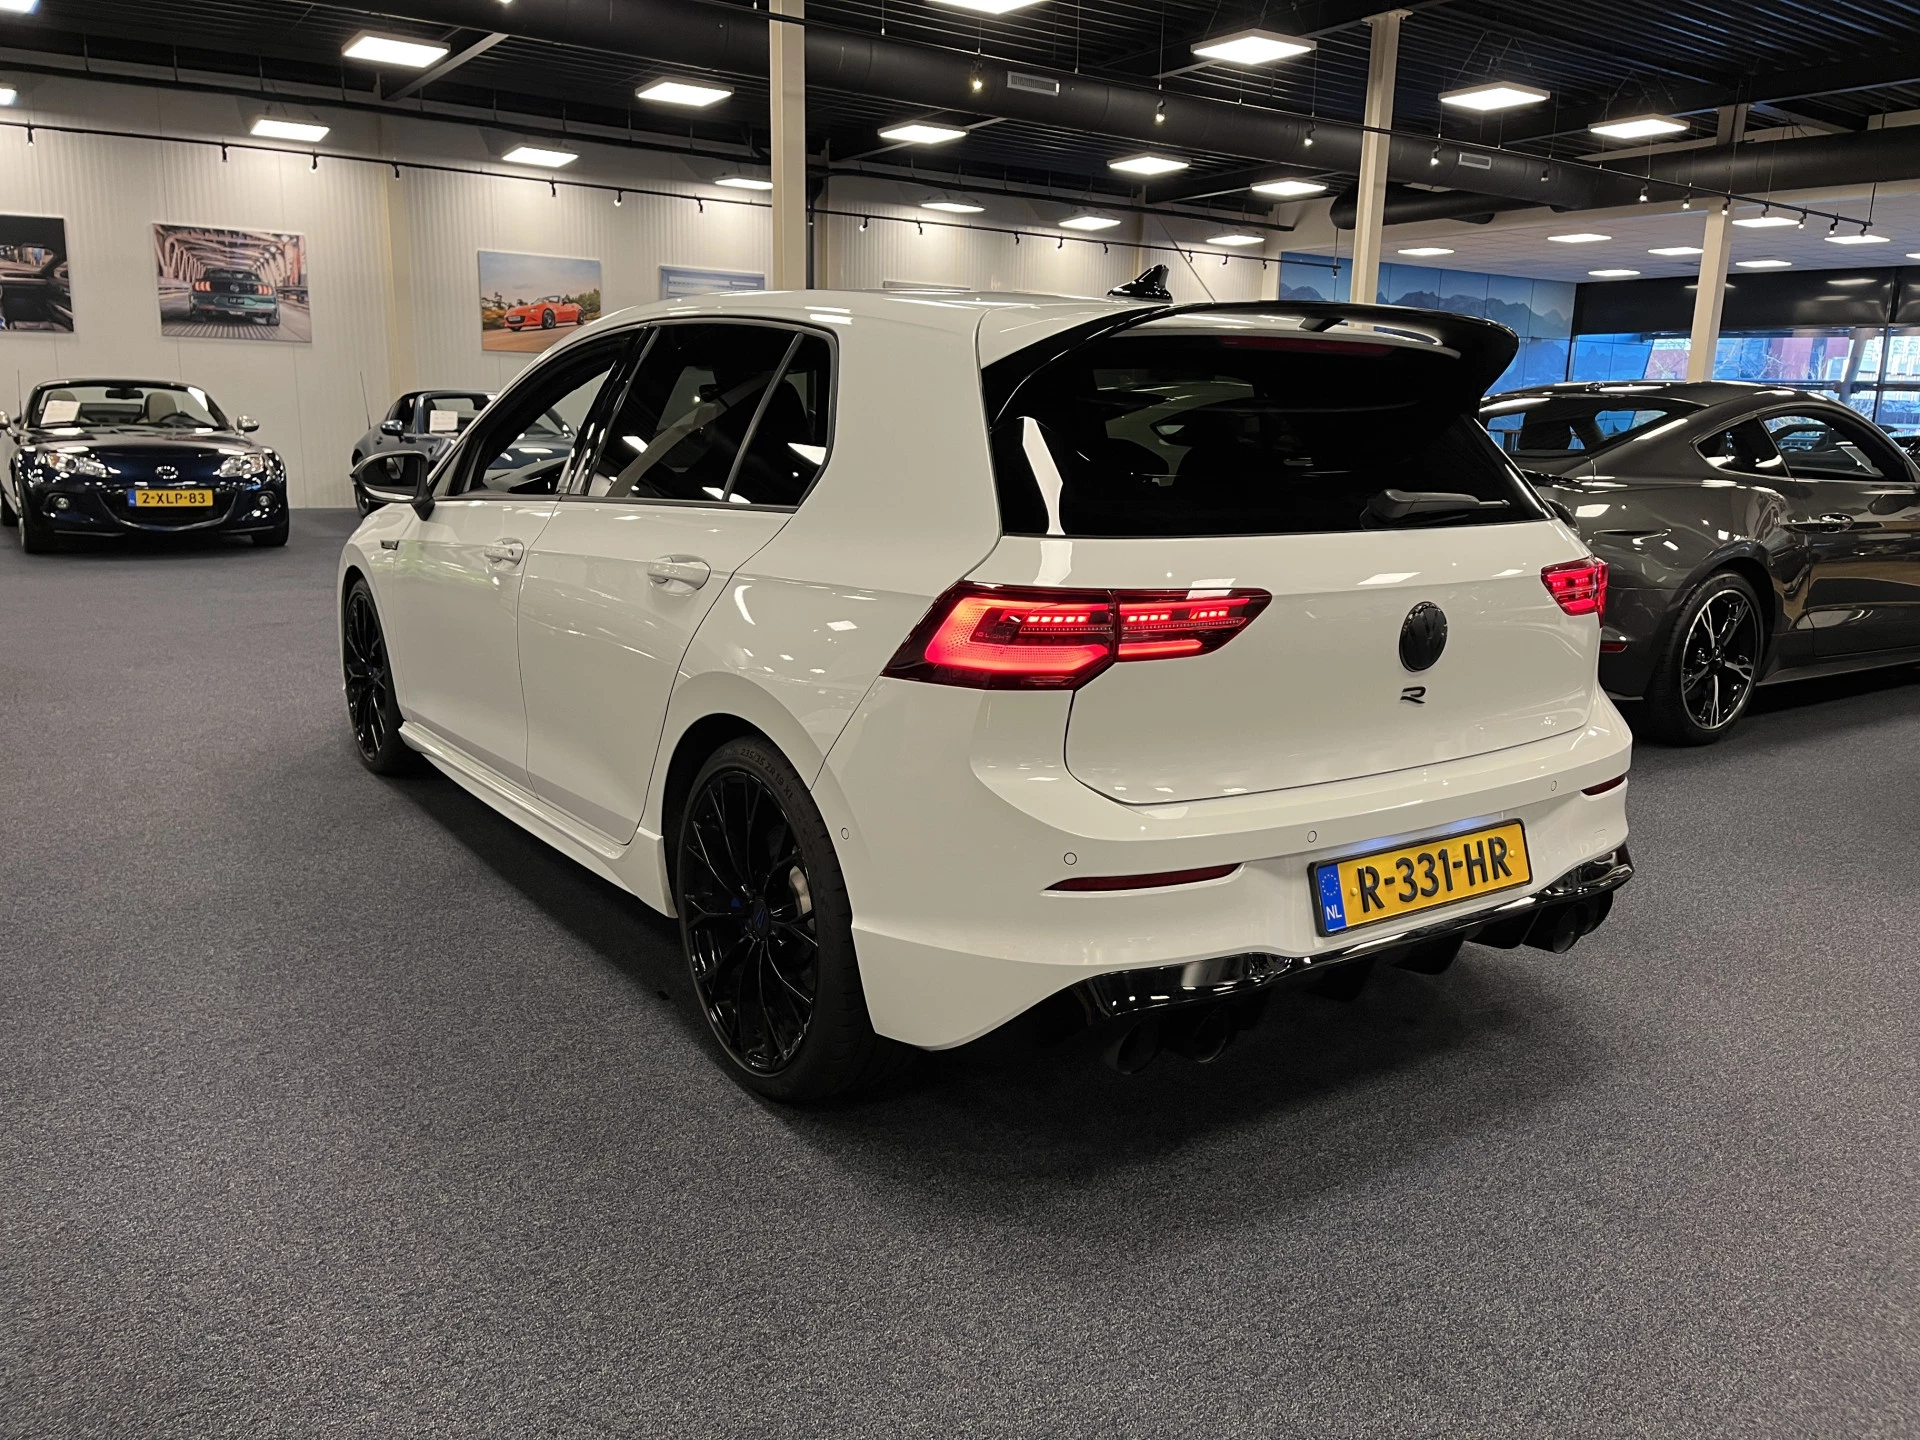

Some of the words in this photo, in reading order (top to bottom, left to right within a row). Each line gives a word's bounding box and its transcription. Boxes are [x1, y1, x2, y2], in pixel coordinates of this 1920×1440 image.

[141, 493, 205, 504] 2-XLP-83
[1400, 686, 1426, 704] R
[740, 748, 766, 766] 235/35
[783, 784, 794, 802] XL
[1357, 836, 1513, 913] R-331-HR
[1325, 904, 1342, 920] NL
